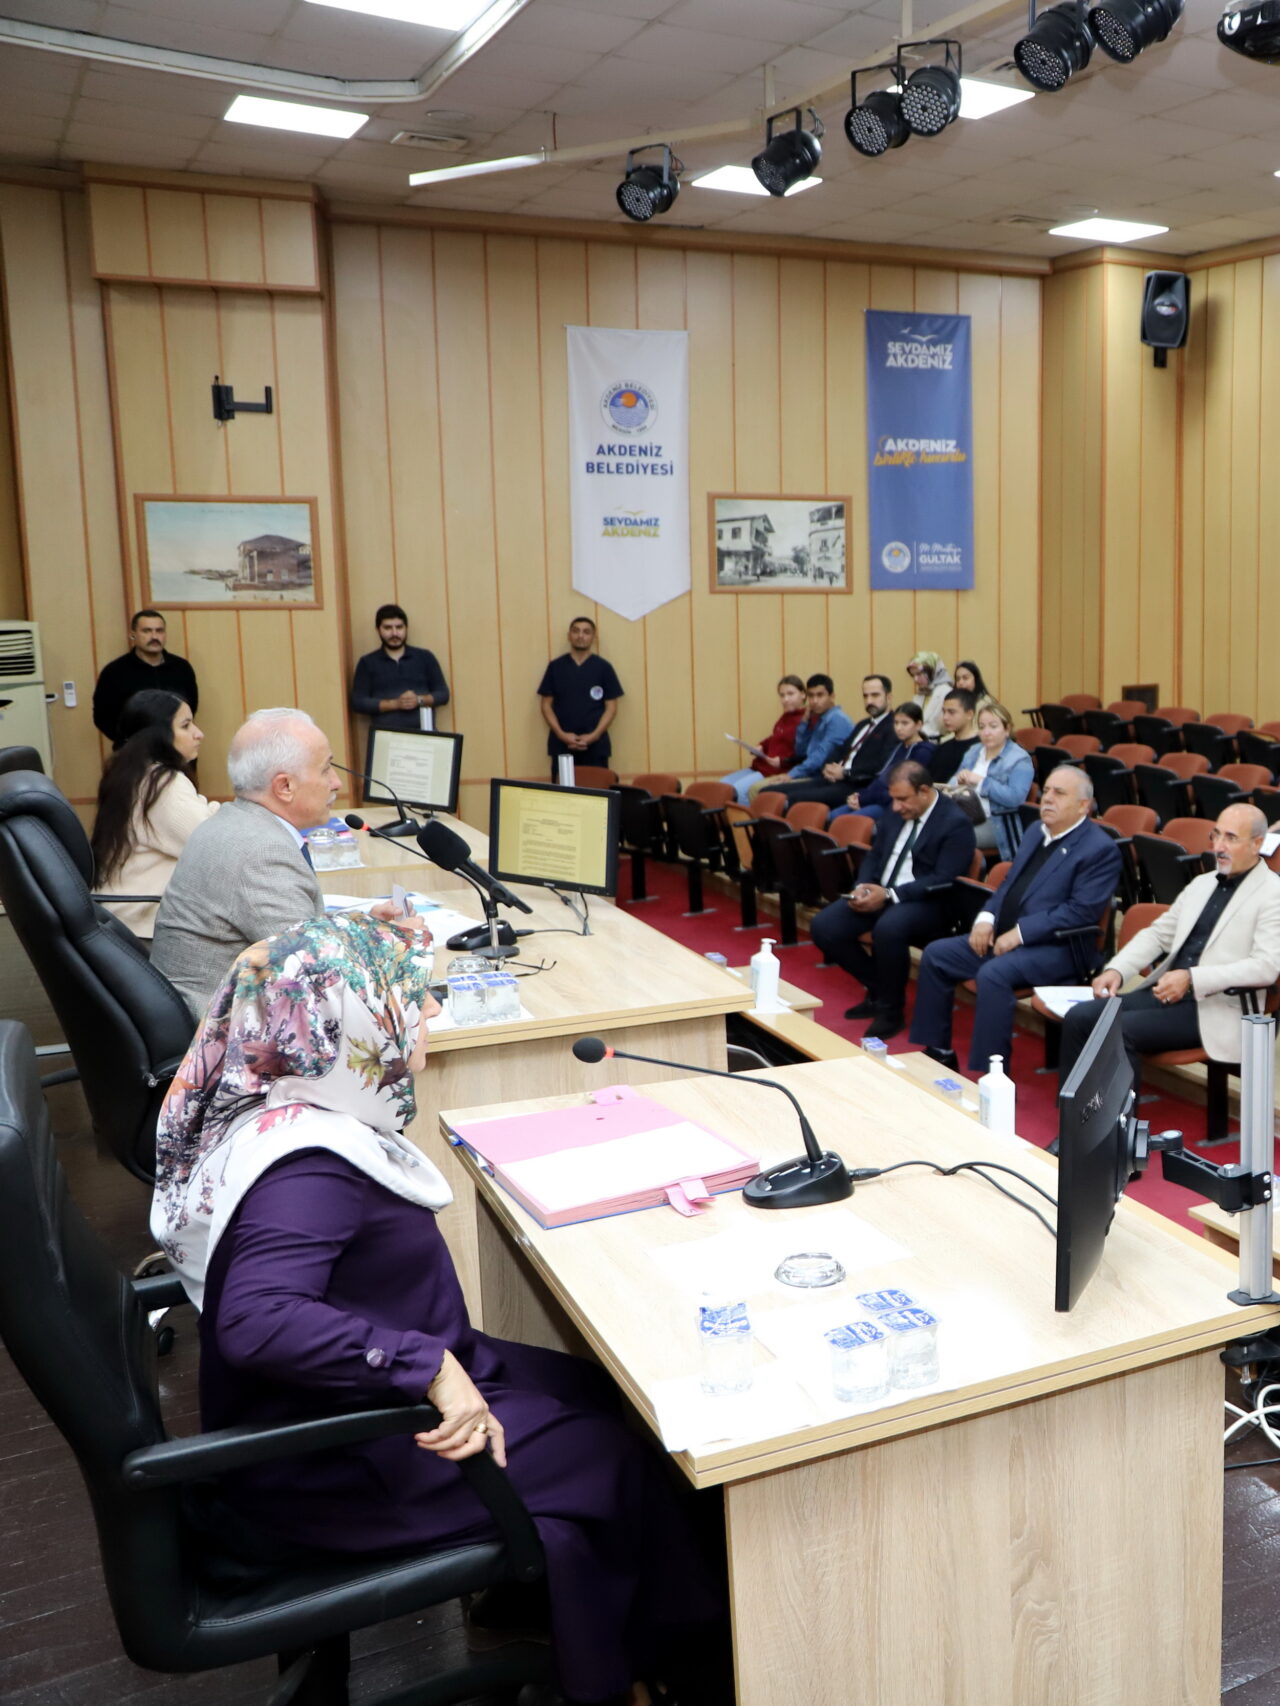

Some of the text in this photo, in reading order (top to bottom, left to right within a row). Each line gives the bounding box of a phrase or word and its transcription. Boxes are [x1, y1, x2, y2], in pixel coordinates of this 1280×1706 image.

[887, 341, 953, 355] SEVDAMIZ
[596, 442, 662, 457] AKDENİZ
[585, 460, 674, 476] BELEDİYESİ
[602, 517, 660, 527] SEVDAMIZ
